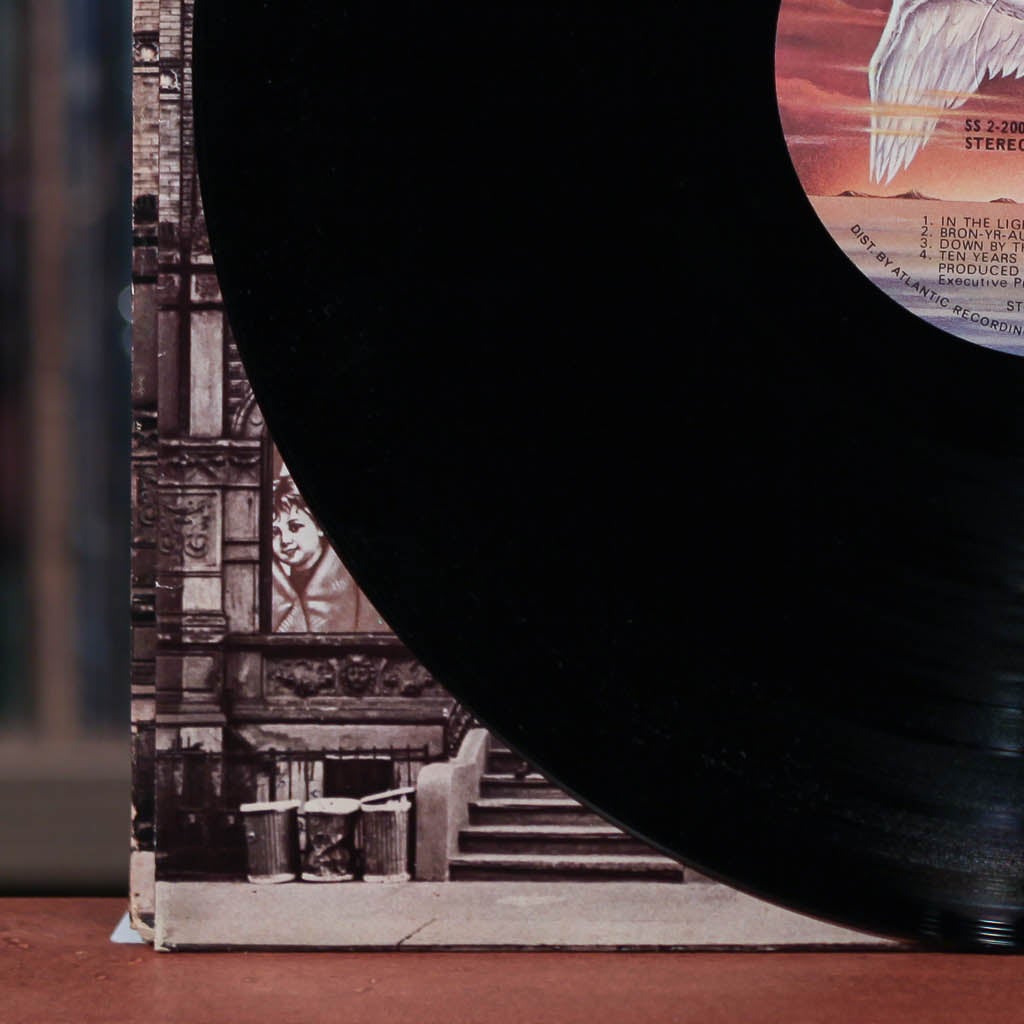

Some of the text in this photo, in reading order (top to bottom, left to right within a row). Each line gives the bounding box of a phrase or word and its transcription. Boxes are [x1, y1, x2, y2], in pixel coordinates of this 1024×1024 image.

[964, 119, 981, 132] SS
[922, 215, 933, 226] 1.
[941, 216, 956, 227] IN
[963, 217, 990, 228] THE
[920, 226, 933, 237] 2.
[920, 238, 932, 249] 3.
[939, 238, 984, 251] DOWN
[990, 241, 1006, 252] BY
[919, 249, 932, 260] 4.
[939, 250, 966, 261] TEN
[973, 251, 1017, 264] YEARS
[850, 224, 876, 254] DIST.
[875, 252, 894, 268] BY
[891, 266, 950, 308] ATLANTIC
[938, 263, 1019, 277] PRODUCED
[938, 275, 1008, 288] Executive
